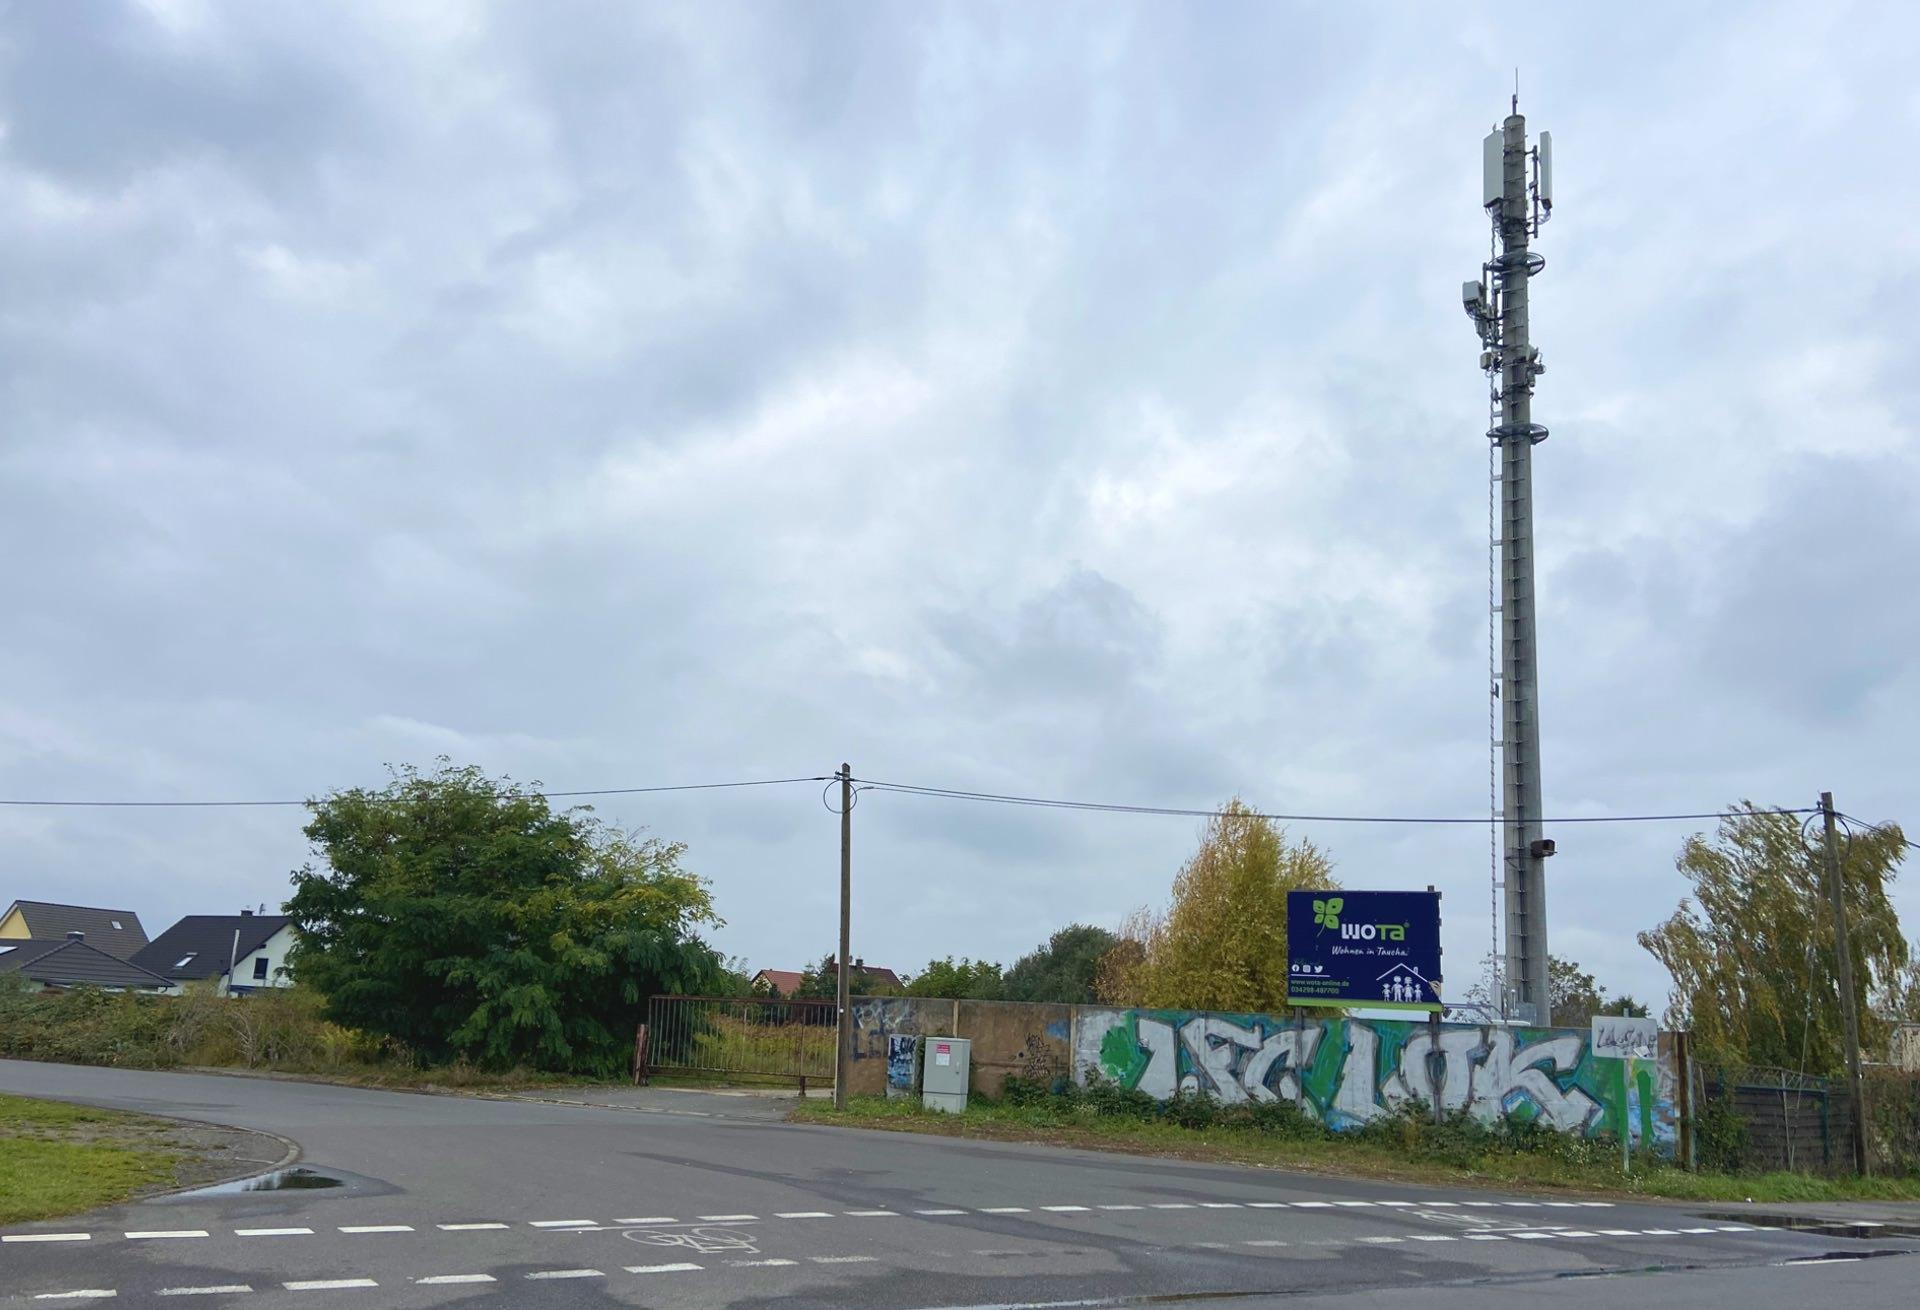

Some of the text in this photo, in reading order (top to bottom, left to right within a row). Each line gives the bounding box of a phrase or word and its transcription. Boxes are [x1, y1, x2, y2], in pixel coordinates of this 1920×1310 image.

[1331, 945, 1364, 956] Wohnen
[1366, 947, 1375, 955] in
[1291, 979, 1350, 987] www.wota-online.de
